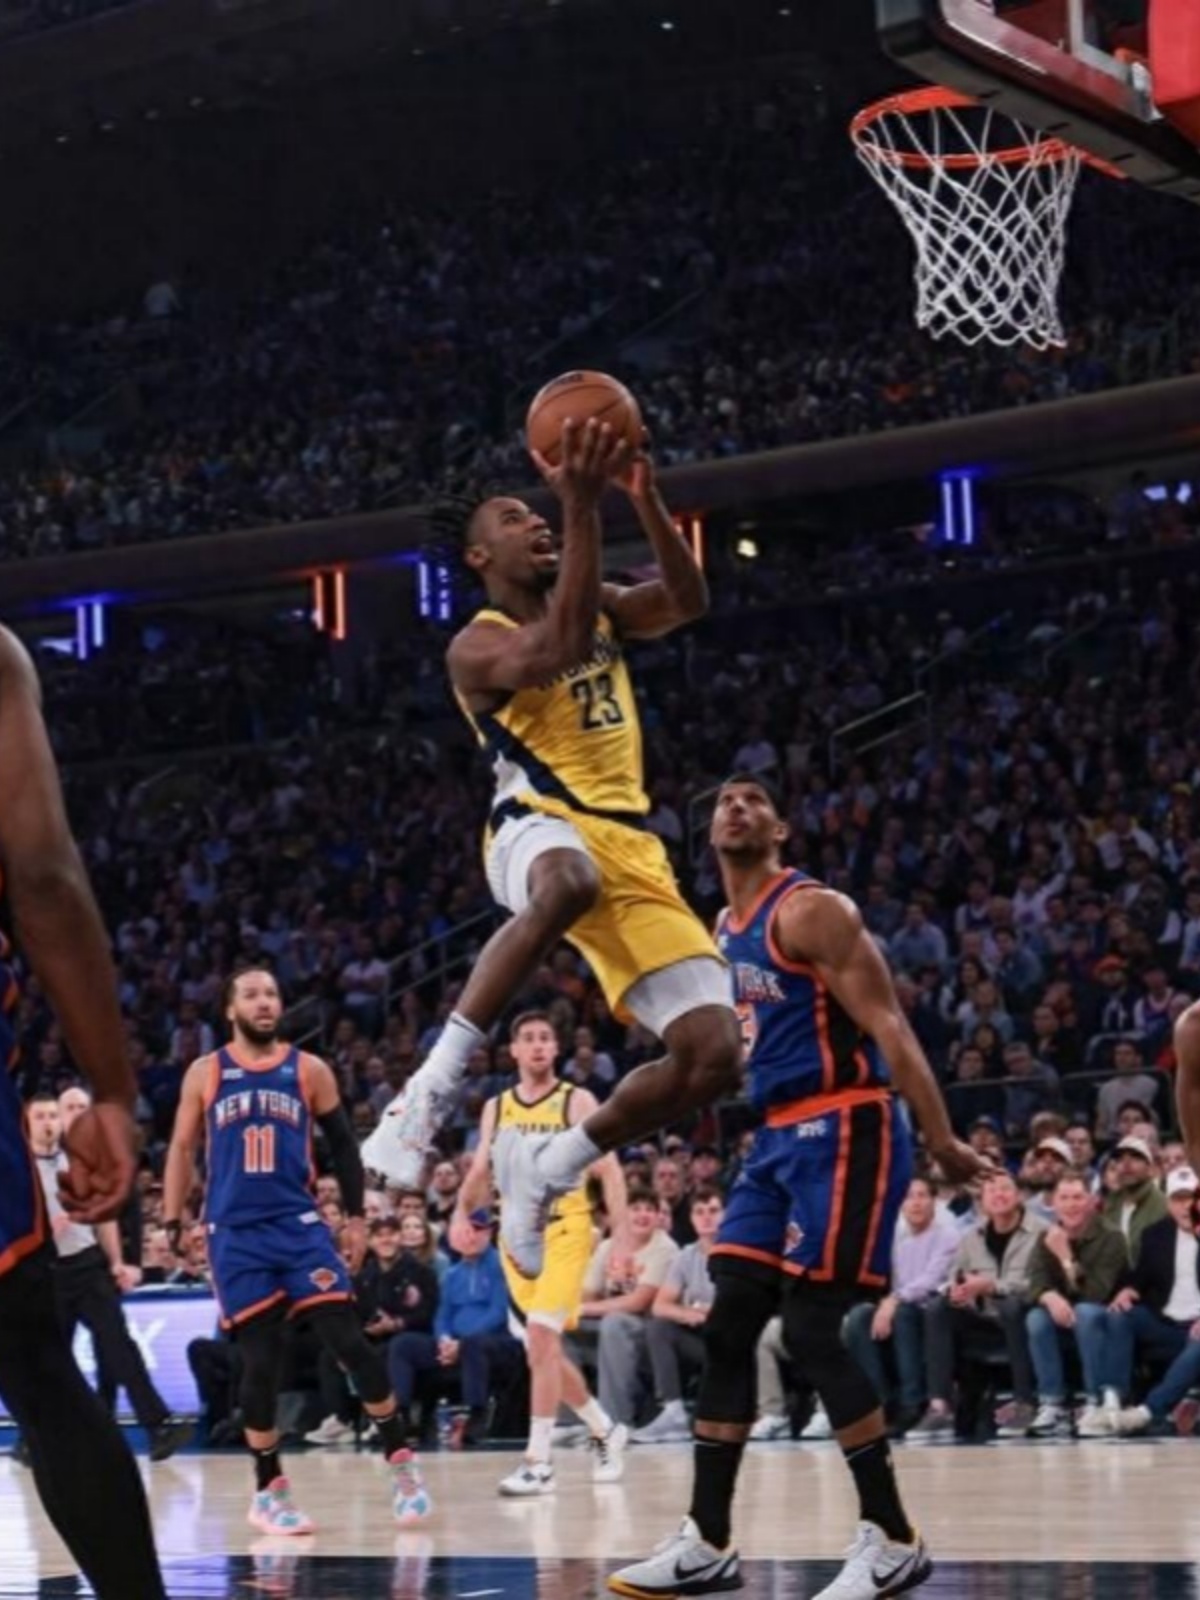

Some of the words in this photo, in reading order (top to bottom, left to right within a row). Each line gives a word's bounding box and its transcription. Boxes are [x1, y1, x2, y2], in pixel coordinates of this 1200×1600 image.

[569, 672, 624, 731] 23
[215, 1090, 252, 1131] NEW
[257, 1089, 301, 1128] YORK
[243, 1123, 275, 1173] 11
